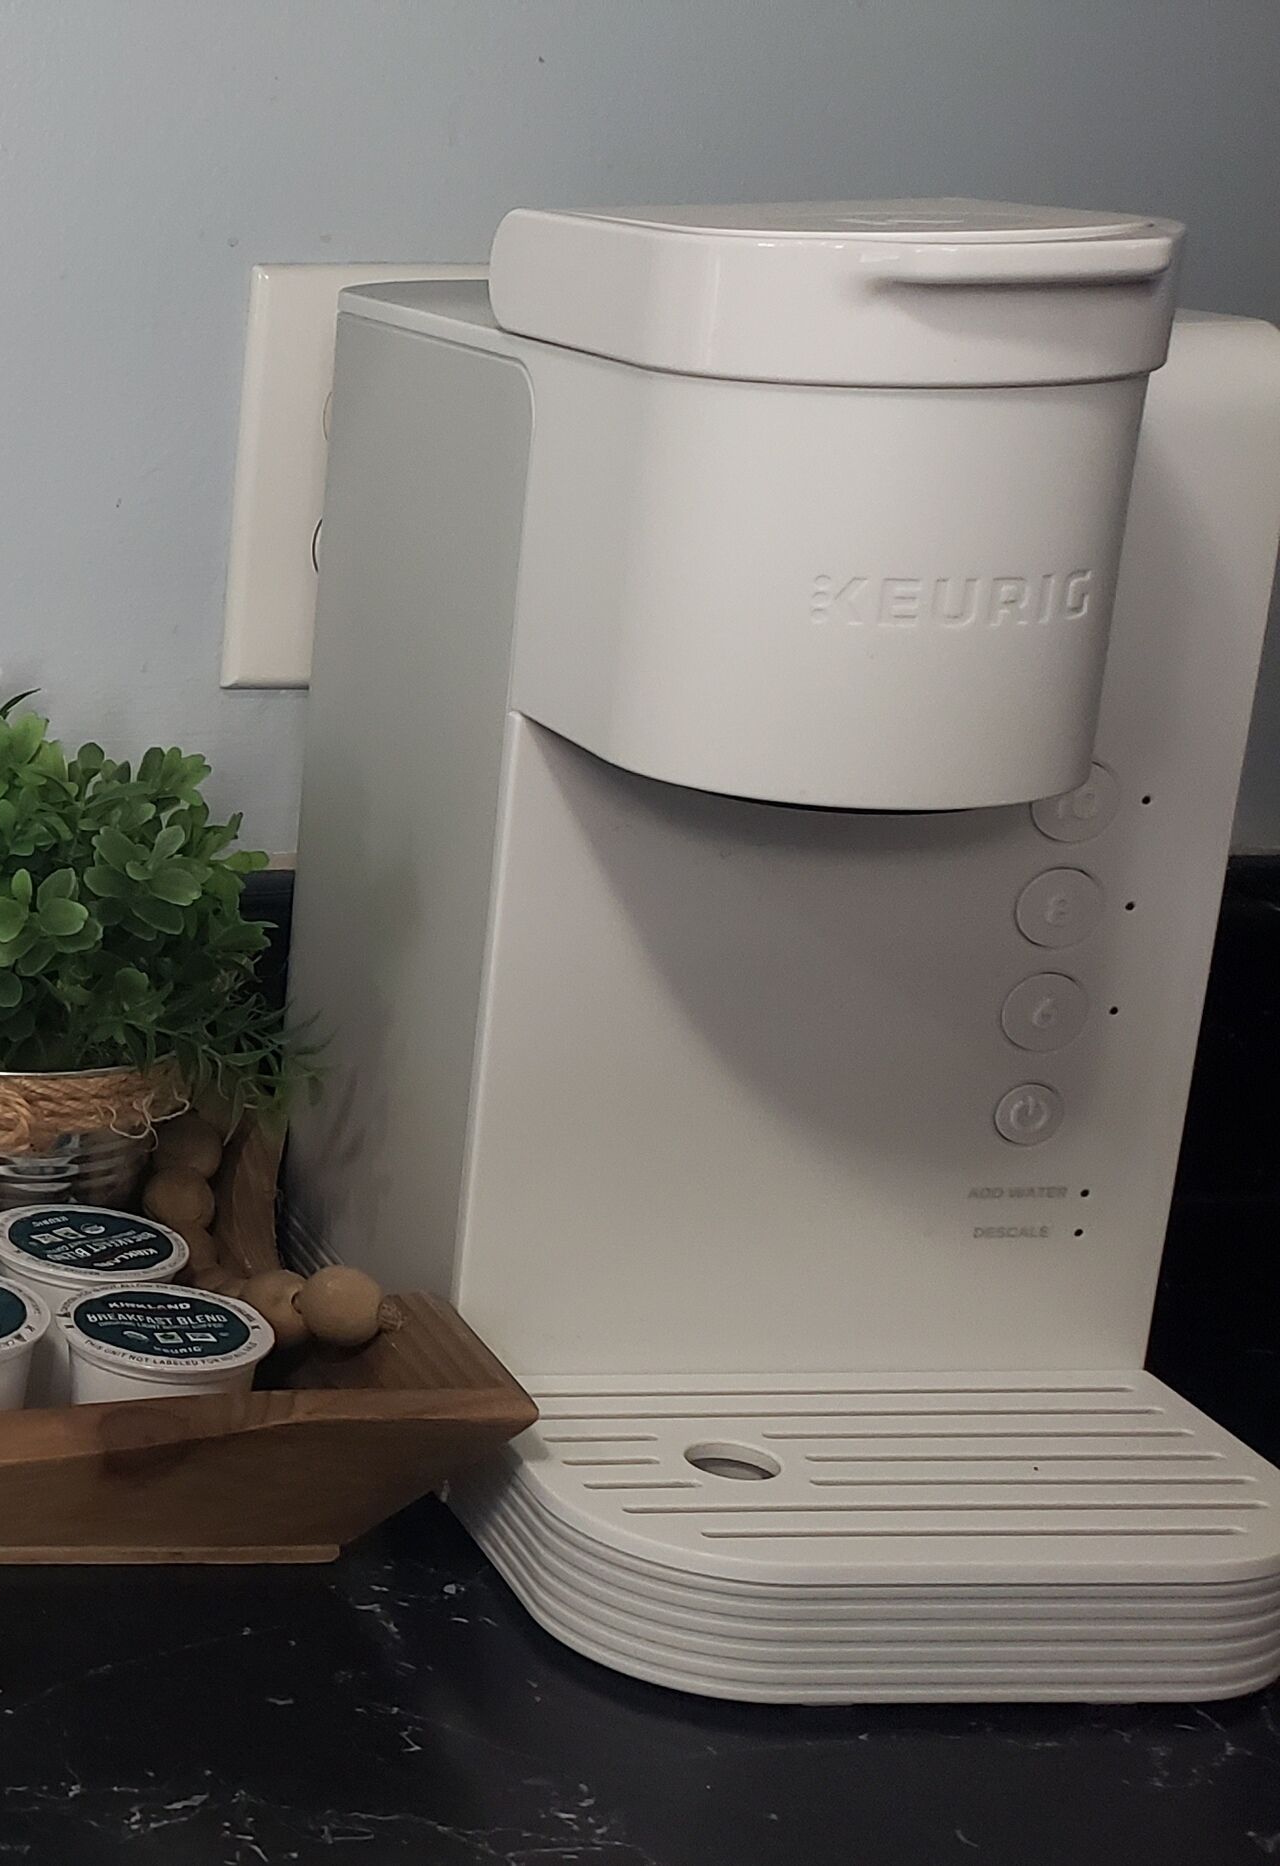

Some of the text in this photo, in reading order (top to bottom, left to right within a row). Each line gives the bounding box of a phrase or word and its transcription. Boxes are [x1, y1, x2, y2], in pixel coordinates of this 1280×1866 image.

[810, 569, 1091, 628] KEURIG
[968, 1186, 1069, 1199] ADD WATER
[973, 1225, 1049, 1239] DESCALE
[92, 1246, 159, 1268] KIRKLAND
[108, 1301, 191, 1311] KIRKLAND
[85, 1313, 229, 1326] BREAKFAST BLEND
[153, 1346, 203, 1355] KEURIG
[129, 1354, 150, 1363] NOT
[152, 1358, 199, 1367] LABELED
